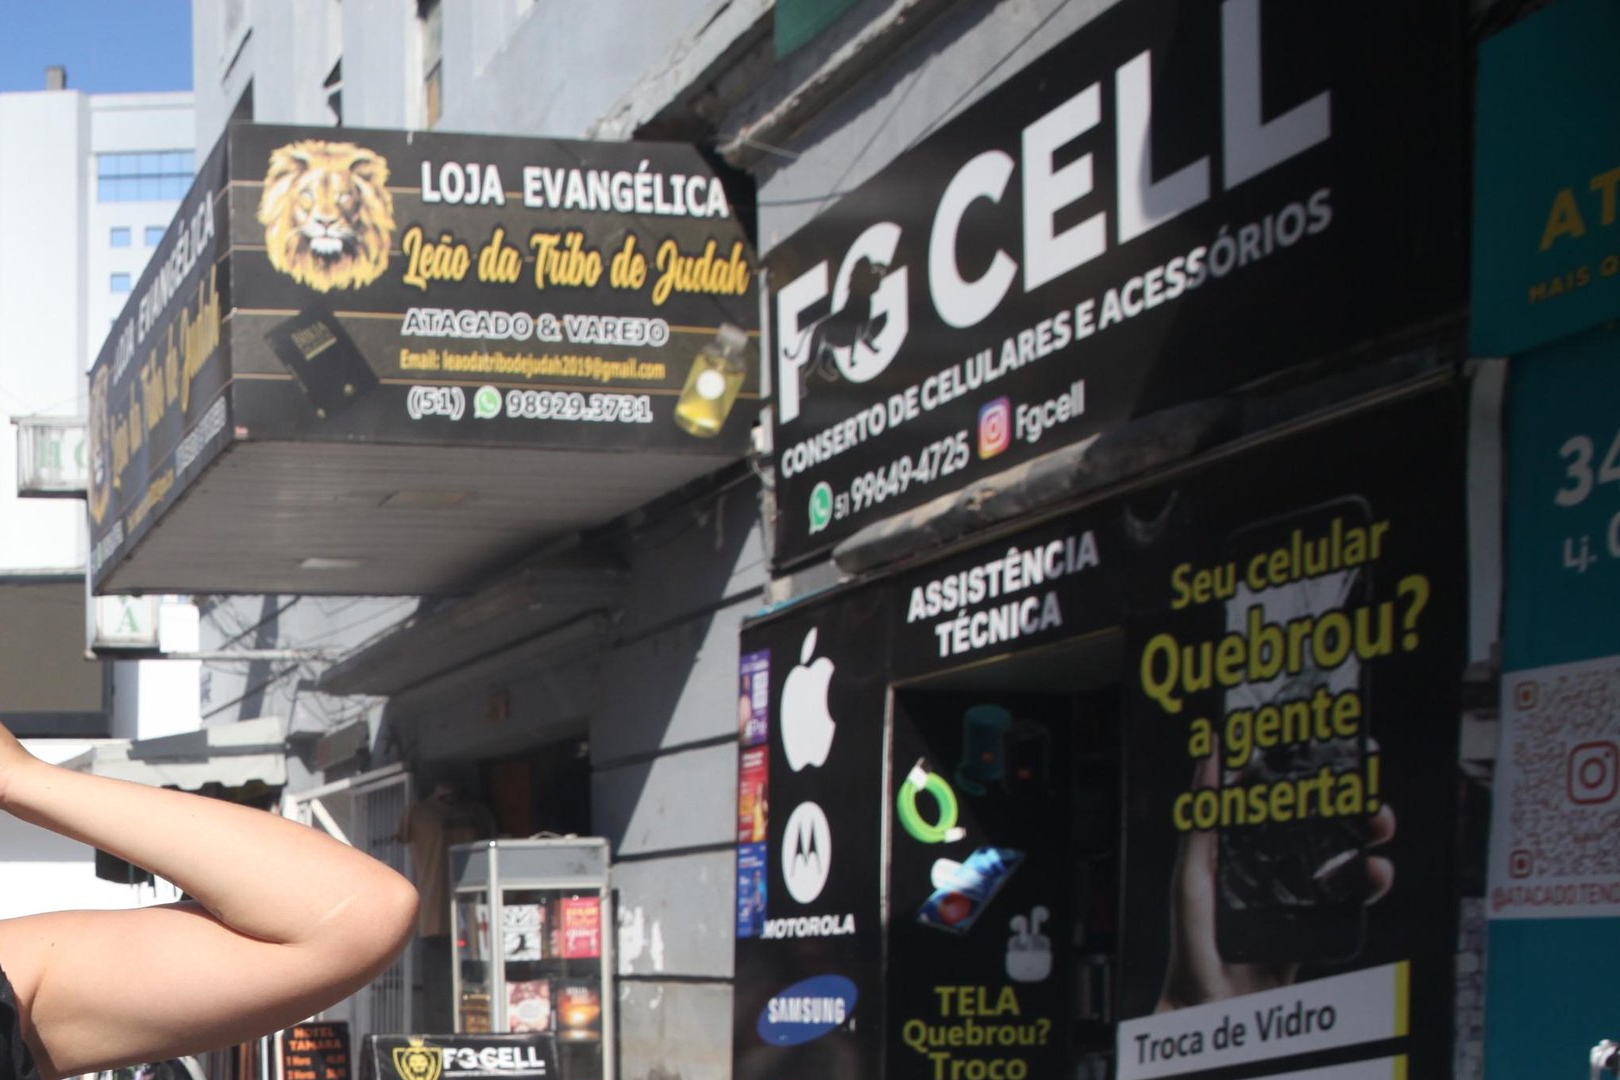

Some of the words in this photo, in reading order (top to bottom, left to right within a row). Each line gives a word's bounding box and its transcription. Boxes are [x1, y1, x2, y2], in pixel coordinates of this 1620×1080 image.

[421, 160, 505, 206] LOJA
[523, 159, 729, 218] EVANGÉLICA
[927, 0, 1331, 329] CELL
[403, 226, 471, 293] Leão
[478, 228, 522, 284] da
[530, 231, 603, 290] Tribo
[611, 234, 647, 290] de
[652, 238, 751, 307] Judah
[400, 348, 440, 370] Email:
[401, 308, 533, 341] ATACADO
[536, 313, 562, 343] &
[564, 314, 670, 348] VAREJO
[782, 402, 886, 479] CONSERTO
[889, 384, 920, 428] DE
[921, 309, 1072, 412] CELULARES
[1075, 299, 1096, 341] E
[1099, 187, 1333, 331] ACESSÓRIOS
[406, 385, 466, 420] (51)
[506, 391, 653, 424] 98929.3731
[1014, 379, 1086, 444] Fgcell
[834, 491, 849, 519] 51
[850, 429, 971, 513] 99649-4725
[907, 530, 1101, 624] ASSISTÊNCIA
[1171, 561, 1236, 610] Seu
[1246, 517, 1391, 590] celular
[935, 592, 1063, 658] TÉCNICA
[1139, 573, 1431, 714] Quebrou?
[1188, 716, 1212, 760] a
[1225, 689, 1362, 769] gente
[1172, 755, 1380, 832] conserta!
[760, 913, 856, 940] MOTOROLA
[768, 996, 846, 1025] SAMSUNG
[902, 1019, 1051, 1048] Quebrou?
[934, 986, 1020, 1017] TELA
[1133, 1029, 1205, 1065] Troca
[1212, 1014, 1246, 1051] de
[1255, 999, 1337, 1043] Vidro
